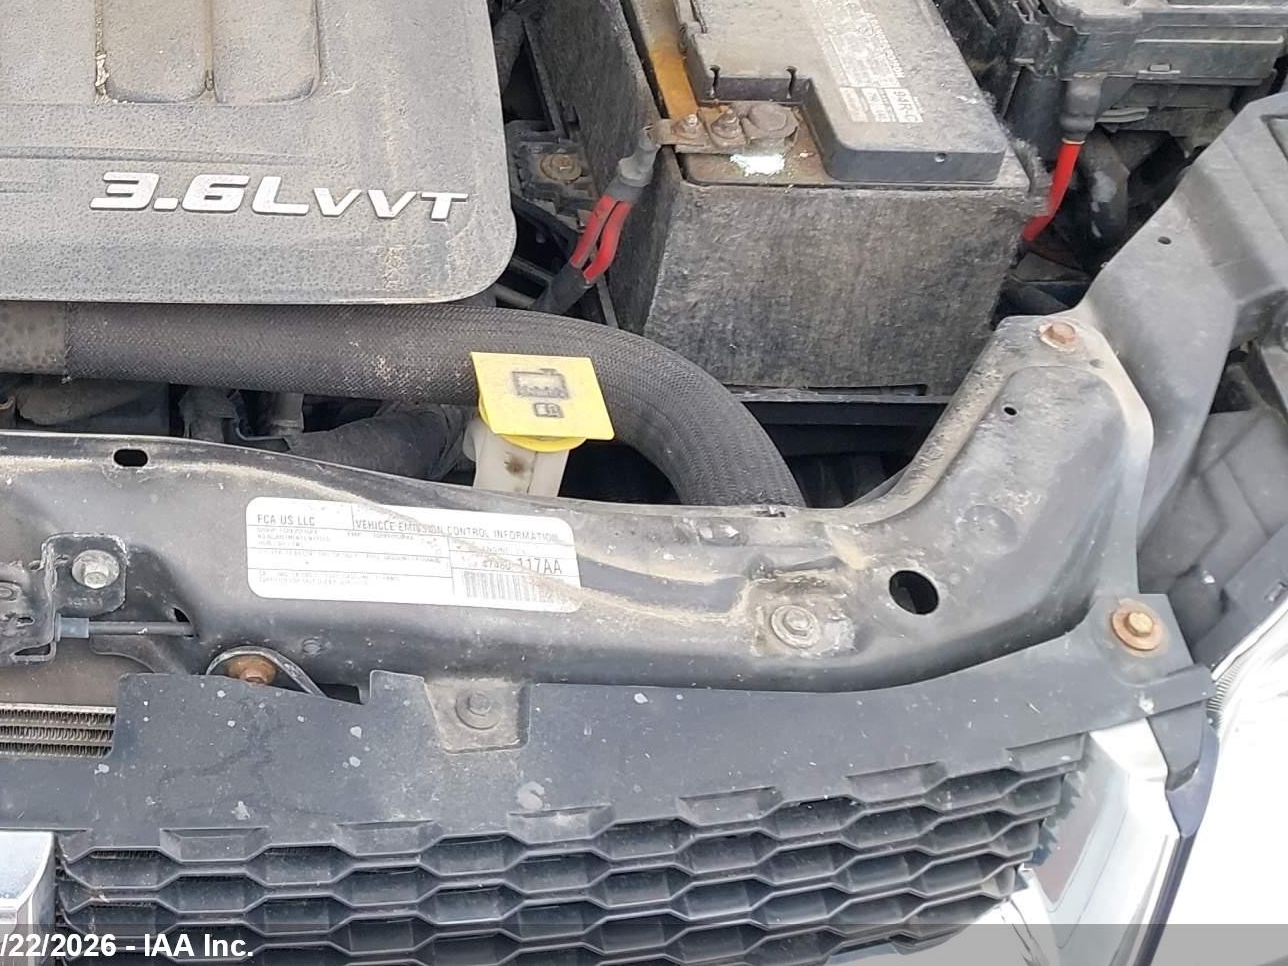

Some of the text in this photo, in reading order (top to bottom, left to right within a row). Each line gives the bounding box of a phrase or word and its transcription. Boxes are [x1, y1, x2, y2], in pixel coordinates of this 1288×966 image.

[257, 514, 276, 525] FCA
[280, 515, 294, 526] US
[297, 516, 315, 527] LLC
[355, 519, 394, 532] VEHICLE
[447, 525, 489, 539] CONTROL
[517, 557, 562, 575] 117AA
